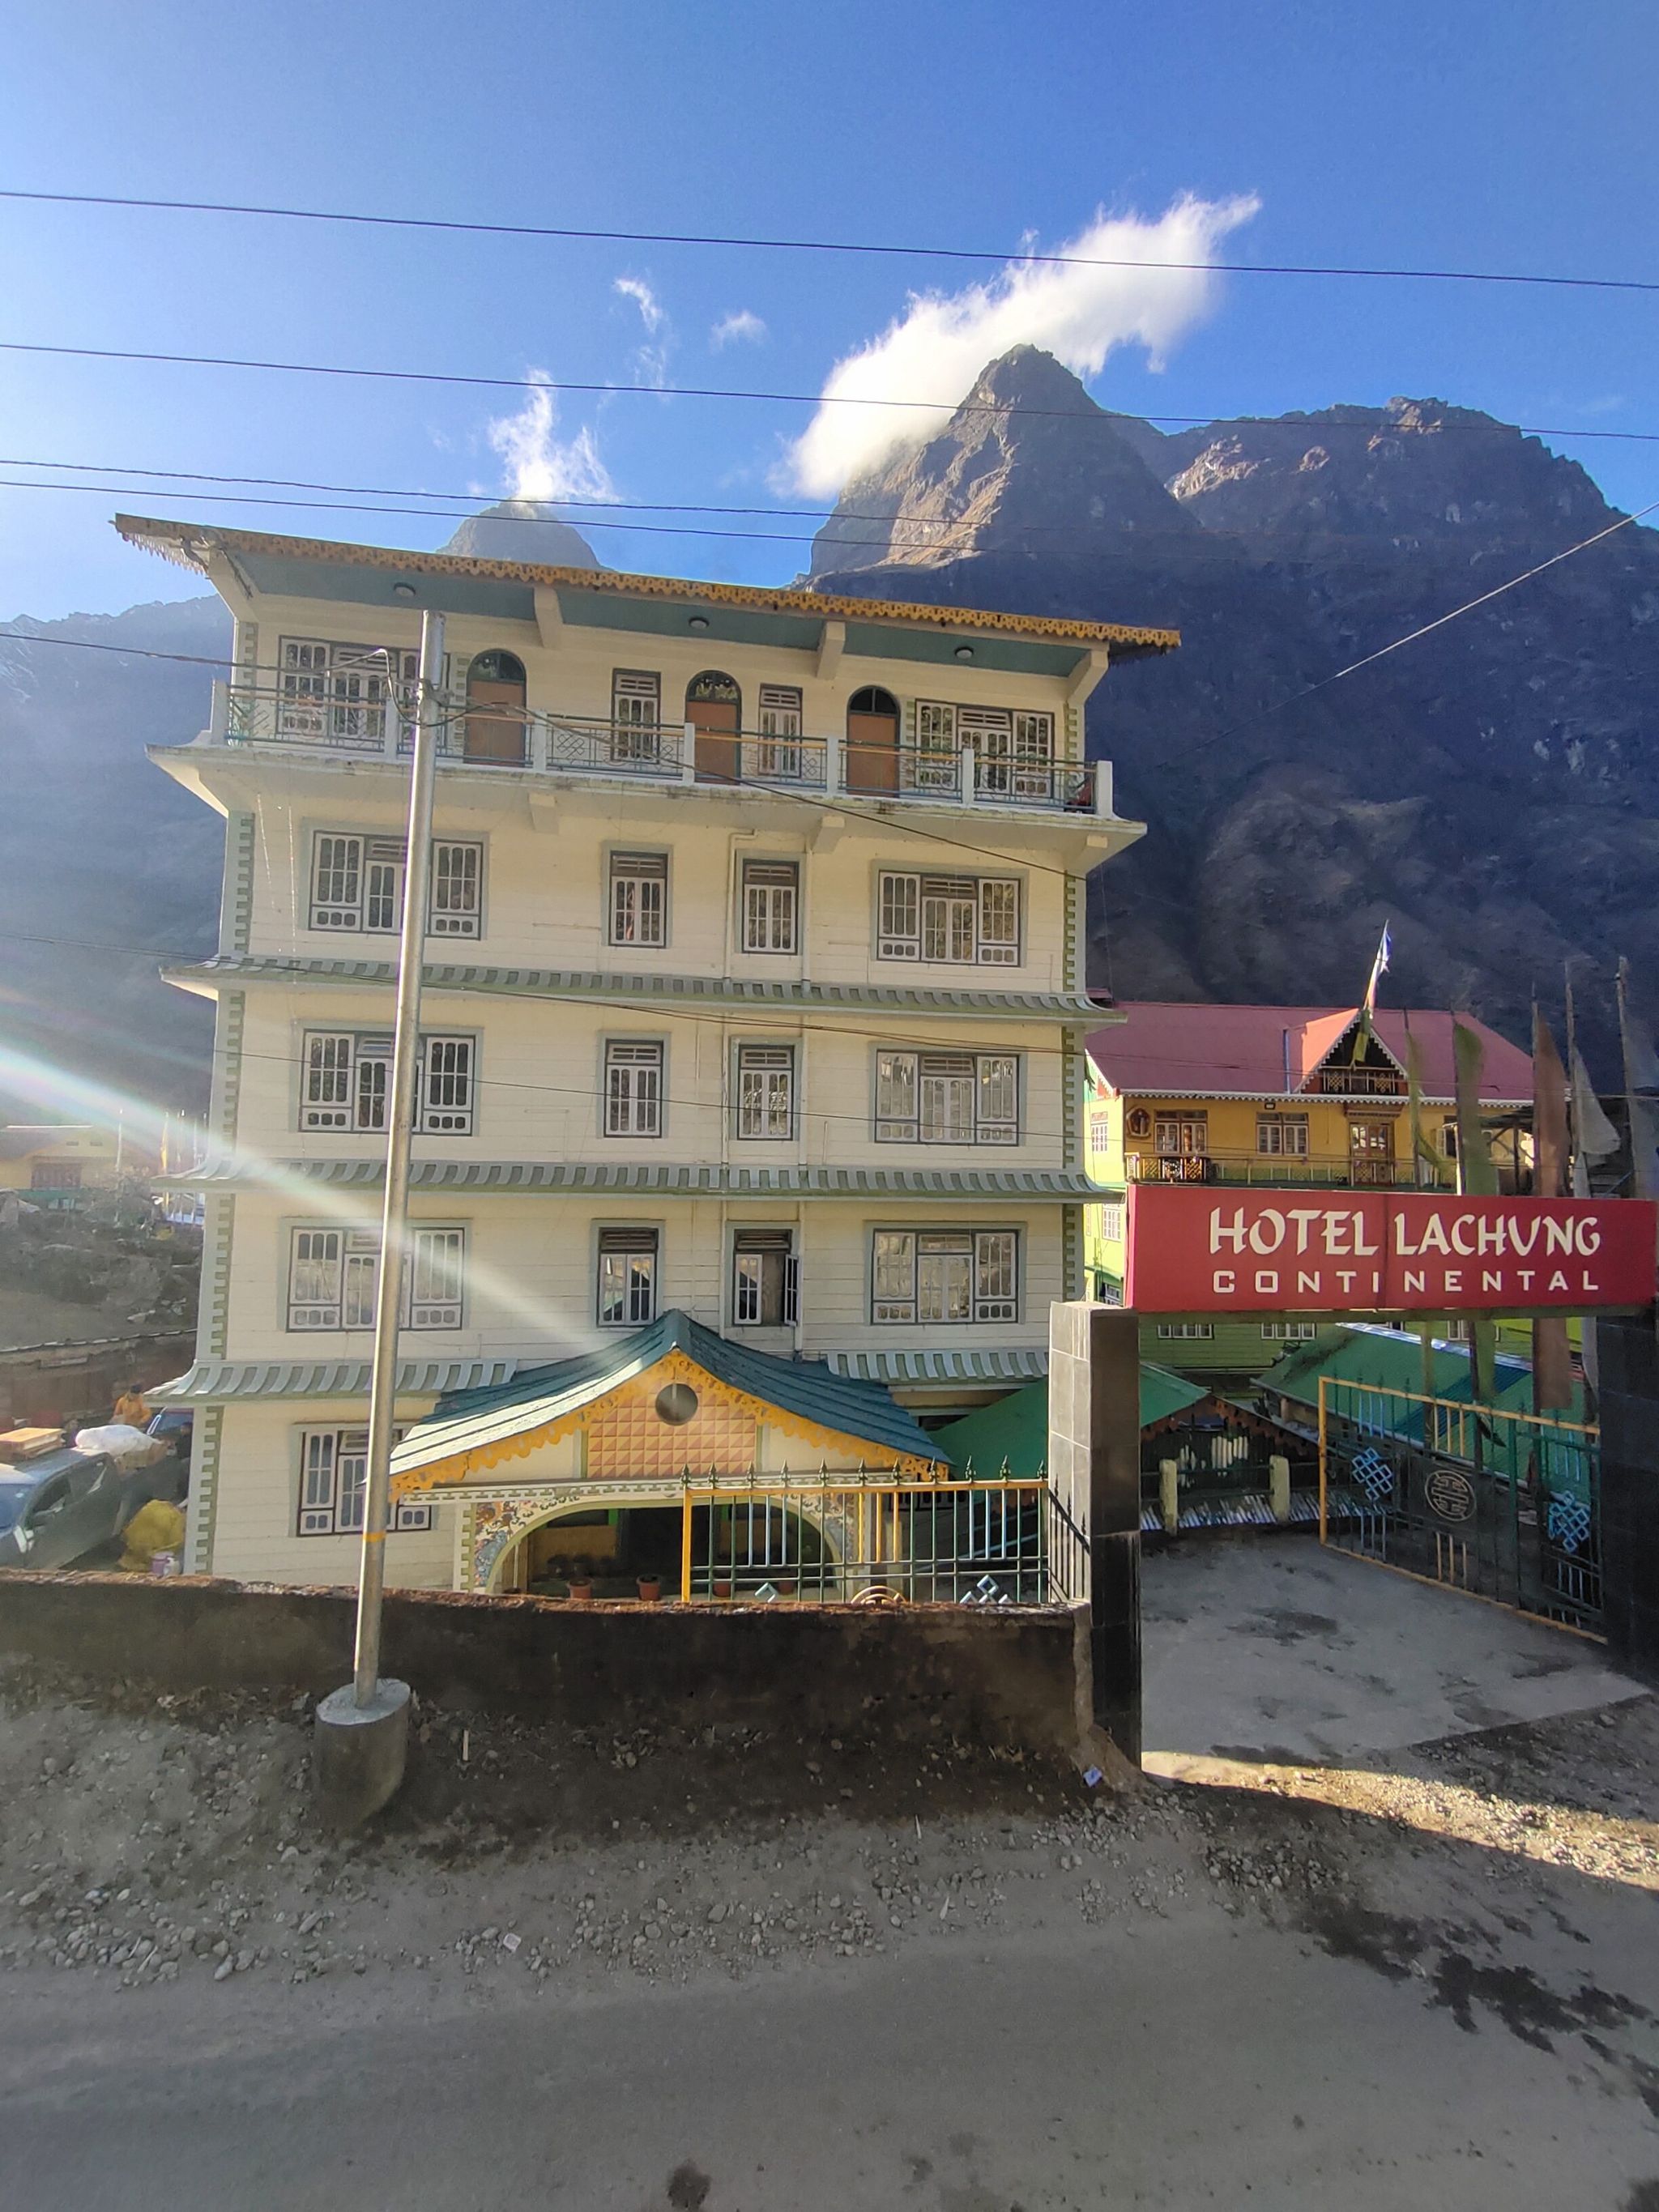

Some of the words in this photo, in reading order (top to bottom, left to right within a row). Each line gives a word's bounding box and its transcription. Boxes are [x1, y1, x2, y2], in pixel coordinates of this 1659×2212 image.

[1209, 1207, 1378, 1256] HOTEL
[1395, 1213, 1601, 1257] LACHUNG
[1213, 1270, 1599, 1294] CONTINENTAL
